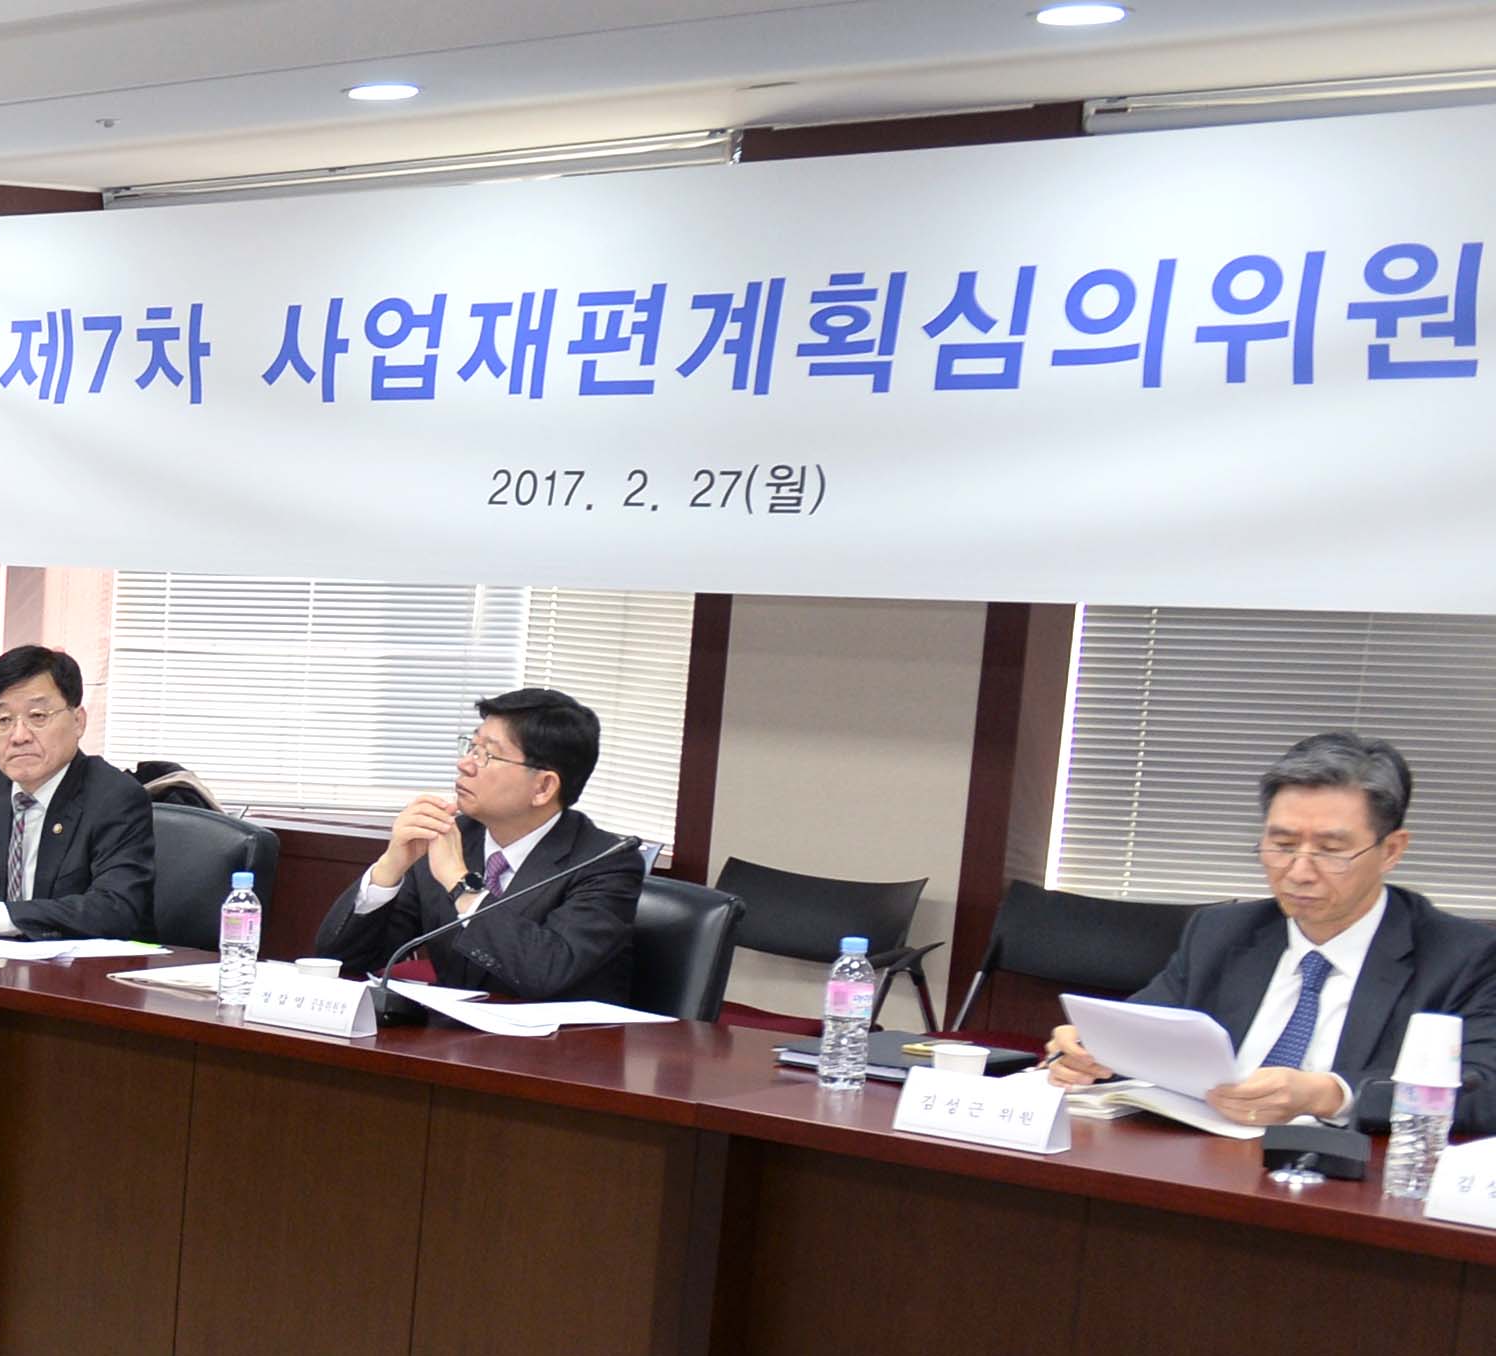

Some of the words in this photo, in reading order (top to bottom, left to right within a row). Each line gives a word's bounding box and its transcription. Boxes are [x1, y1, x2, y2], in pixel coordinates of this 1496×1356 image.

[260, 241, 1485, 404] 사업재편계획심의위원
[486, 468, 594, 511] 2017.
[622, 468, 659, 512] 2.
[689, 463, 827, 516] 27(월)
